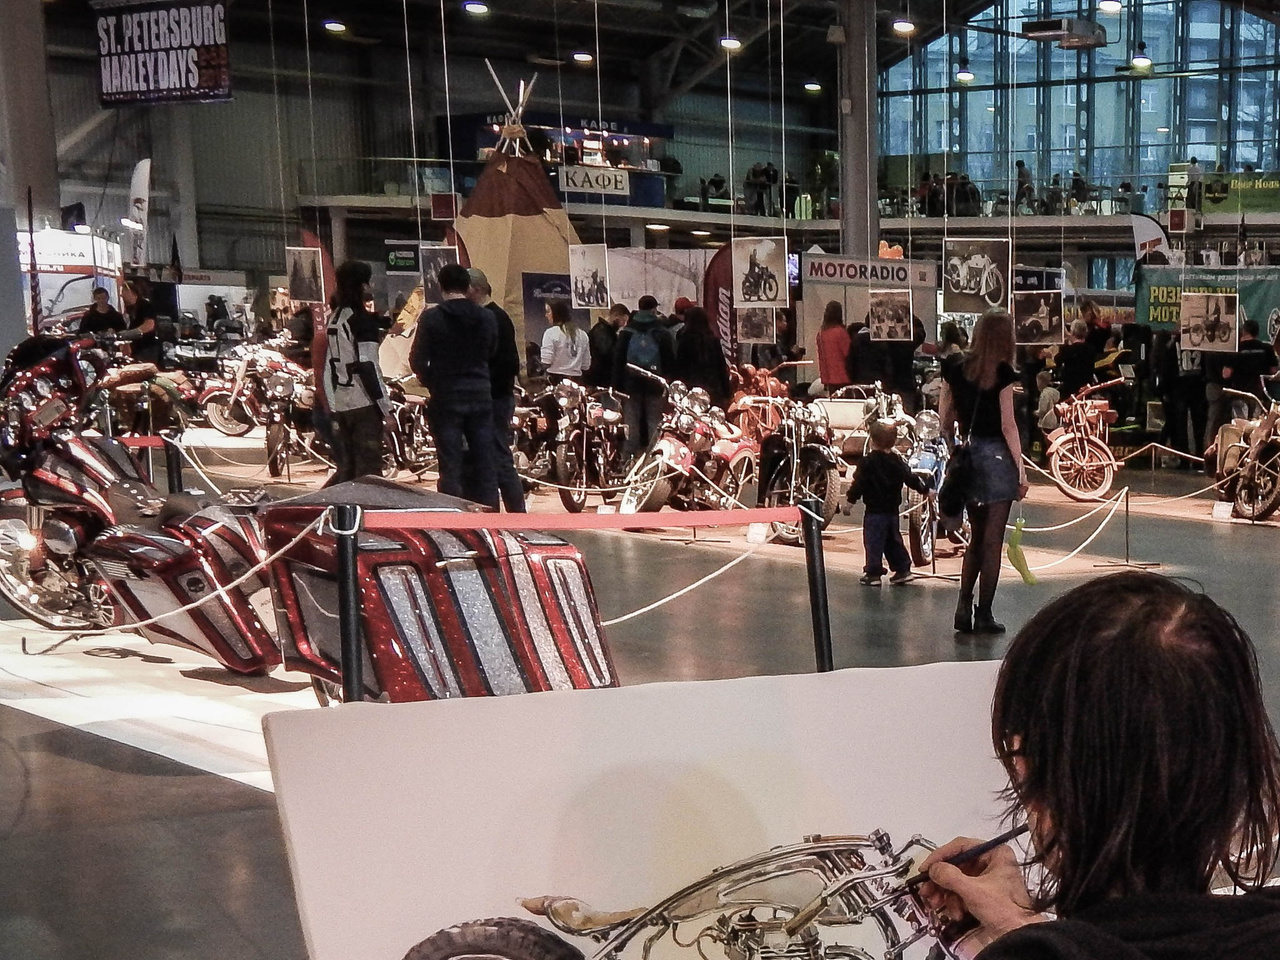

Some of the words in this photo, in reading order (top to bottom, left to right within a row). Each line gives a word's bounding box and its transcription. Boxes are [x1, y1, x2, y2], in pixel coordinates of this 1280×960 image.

[97, 16, 121, 55] ST.
[122, 4, 227, 52] PETERSBURG
[101, 52, 155, 94] HARLEY
[157, 48, 199, 90] DAYS
[581, 118, 618, 131] КАФЕ
[565, 170, 625, 191] КАФЕ
[809, 261, 908, 282] MOTORADIO
[717, 286, 733, 368] ndian
